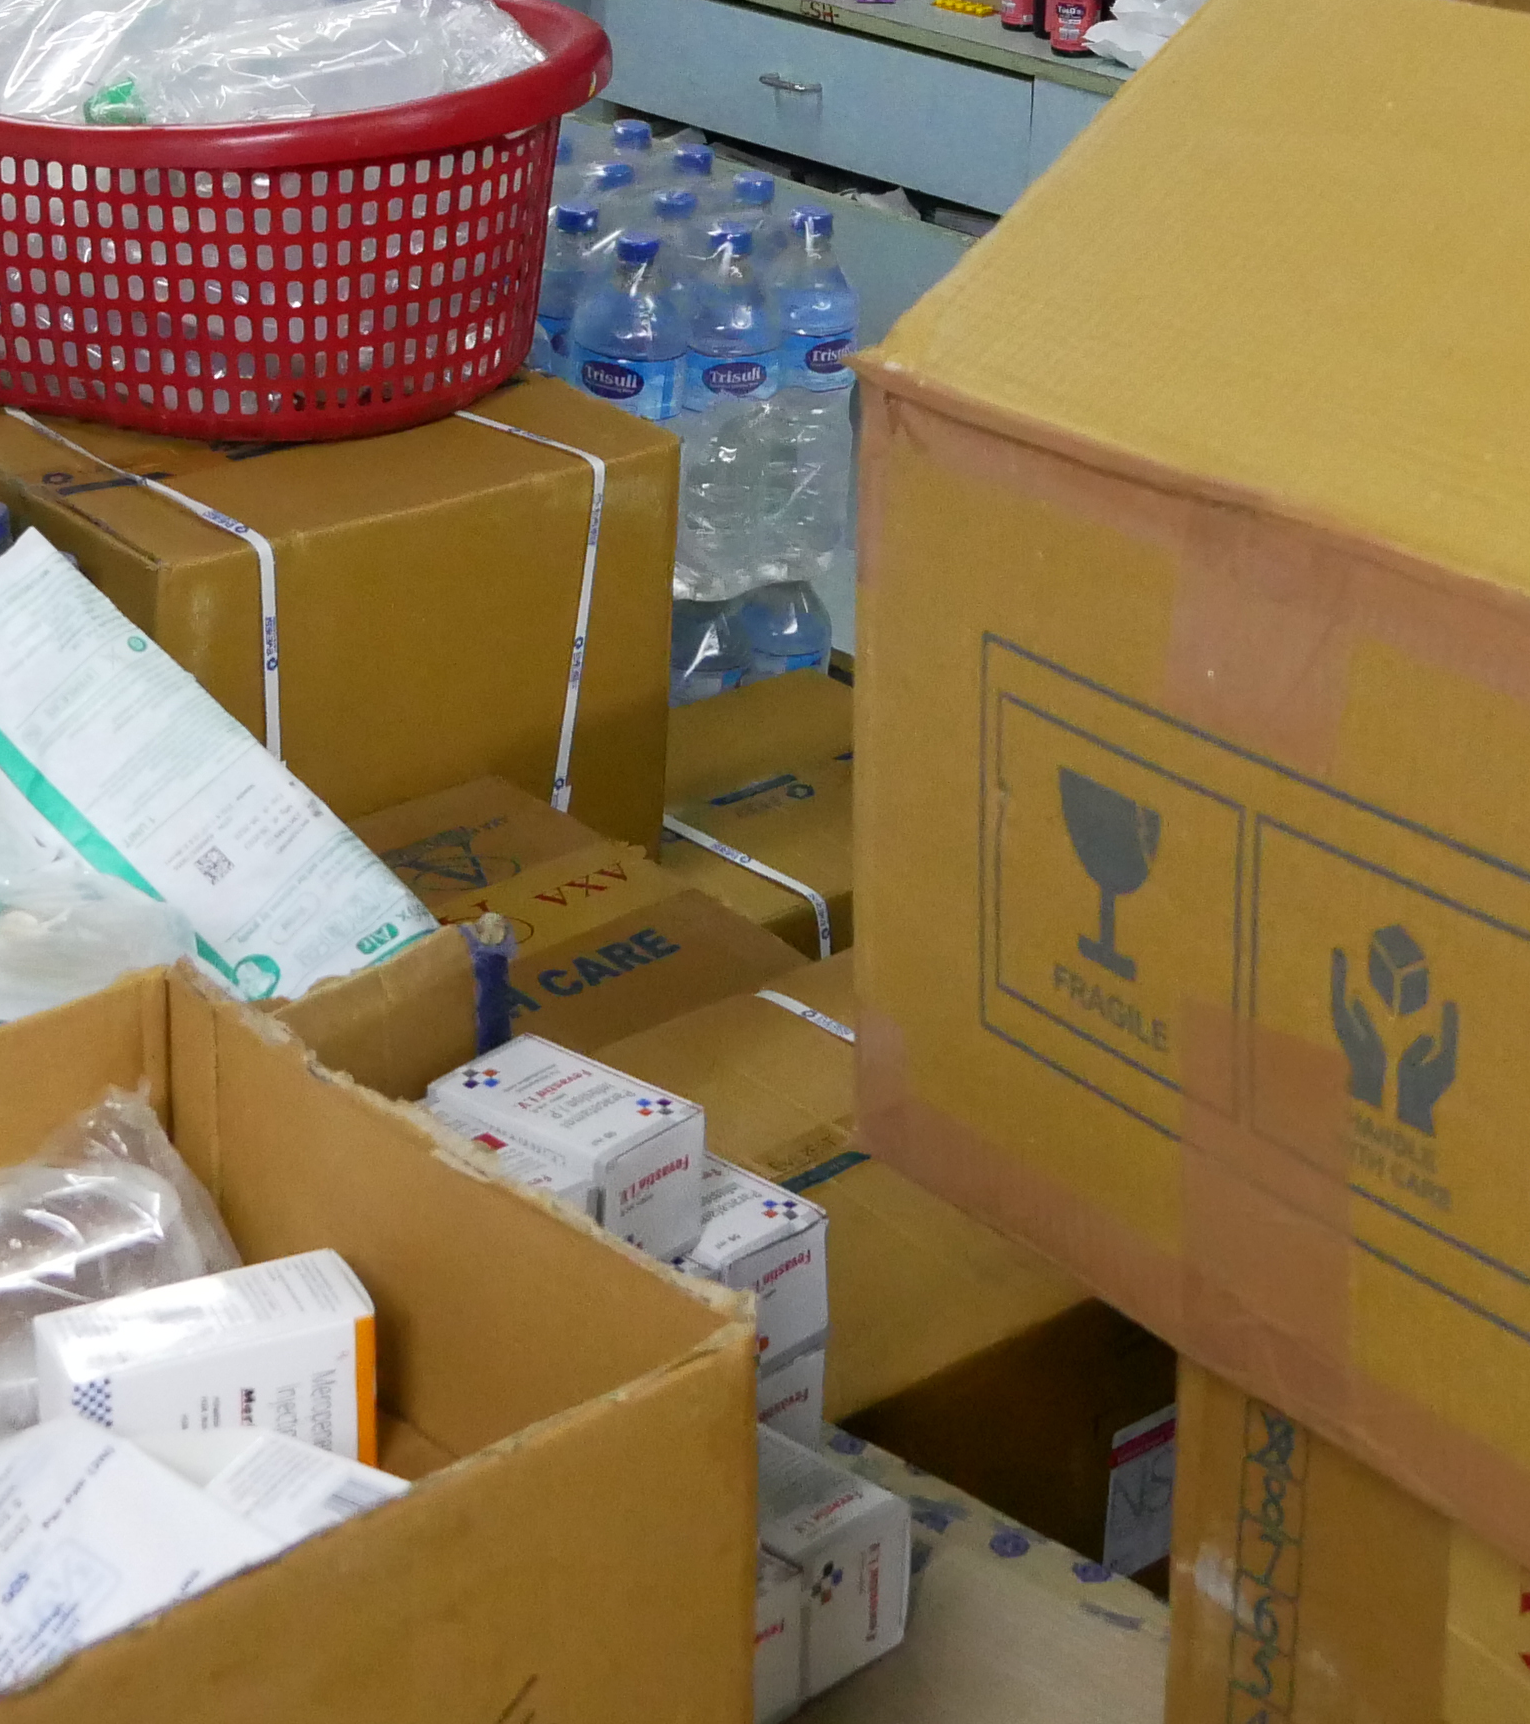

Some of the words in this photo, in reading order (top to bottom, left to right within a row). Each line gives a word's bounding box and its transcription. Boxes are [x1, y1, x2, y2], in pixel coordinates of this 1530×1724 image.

[583, 366, 638, 389] Trisuli
[708, 366, 761, 386] Trisuli
[531, 862, 627, 906] AXA
[537, 928, 681, 997] CARE
[1053, 963, 1170, 1052] FRAGILE
